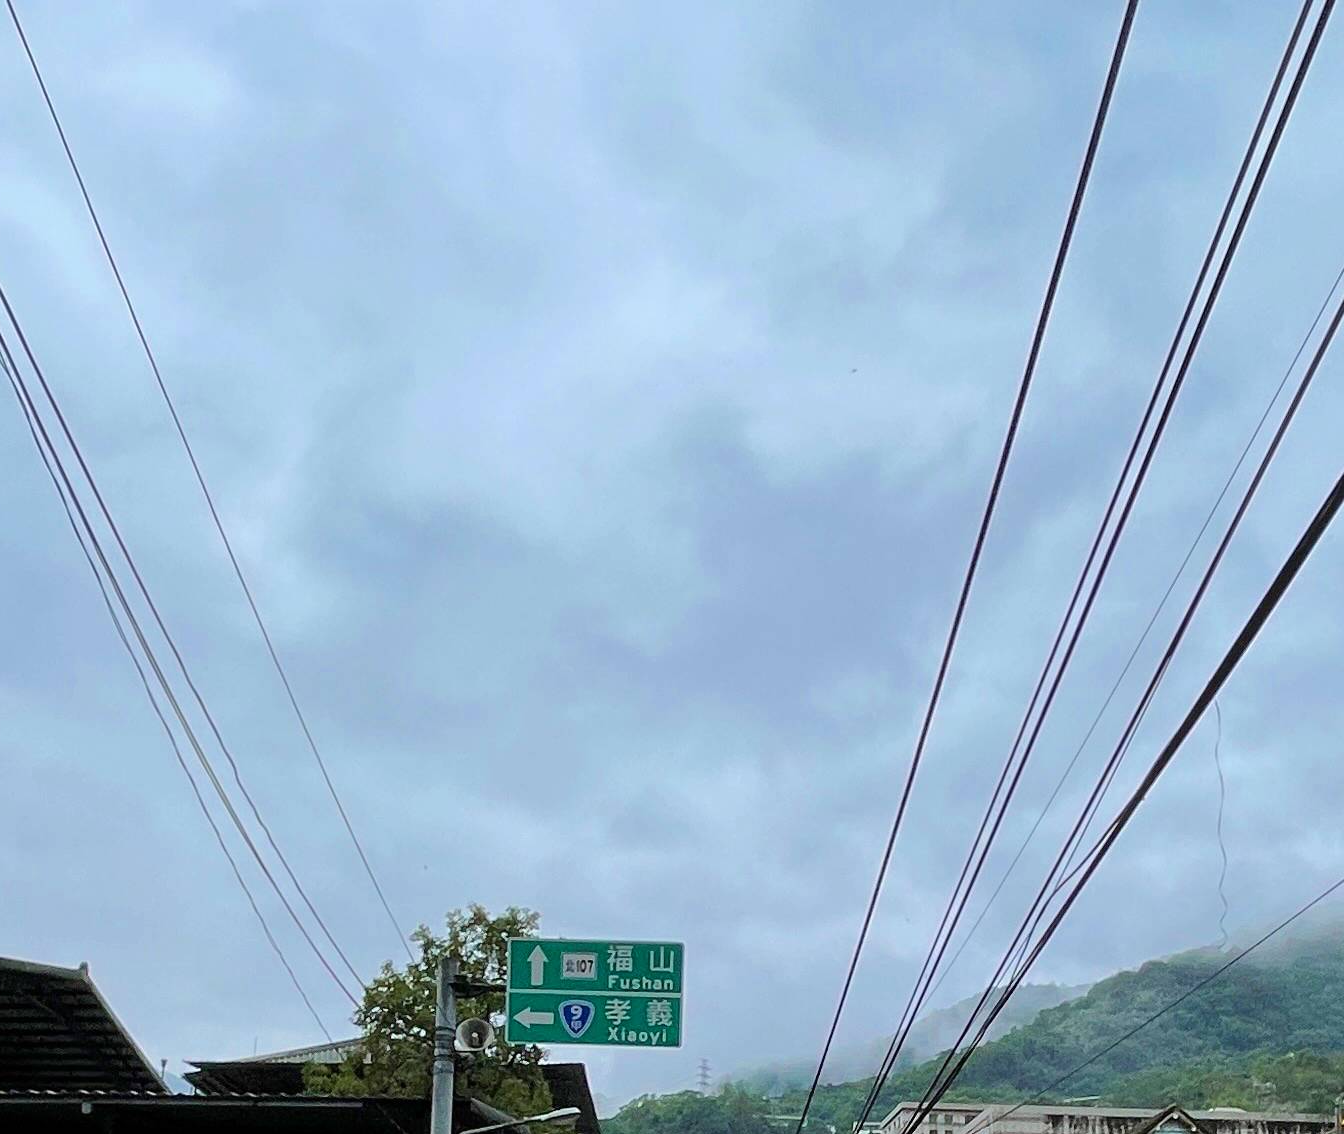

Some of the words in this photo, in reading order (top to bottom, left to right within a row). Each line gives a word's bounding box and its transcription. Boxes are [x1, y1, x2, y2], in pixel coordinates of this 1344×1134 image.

[607, 945, 675, 973] 福山
[608, 975, 674, 991] Fushan
[605, 998, 673, 1027] 孝義
[608, 1027, 667, 1045] Xiaoyi
